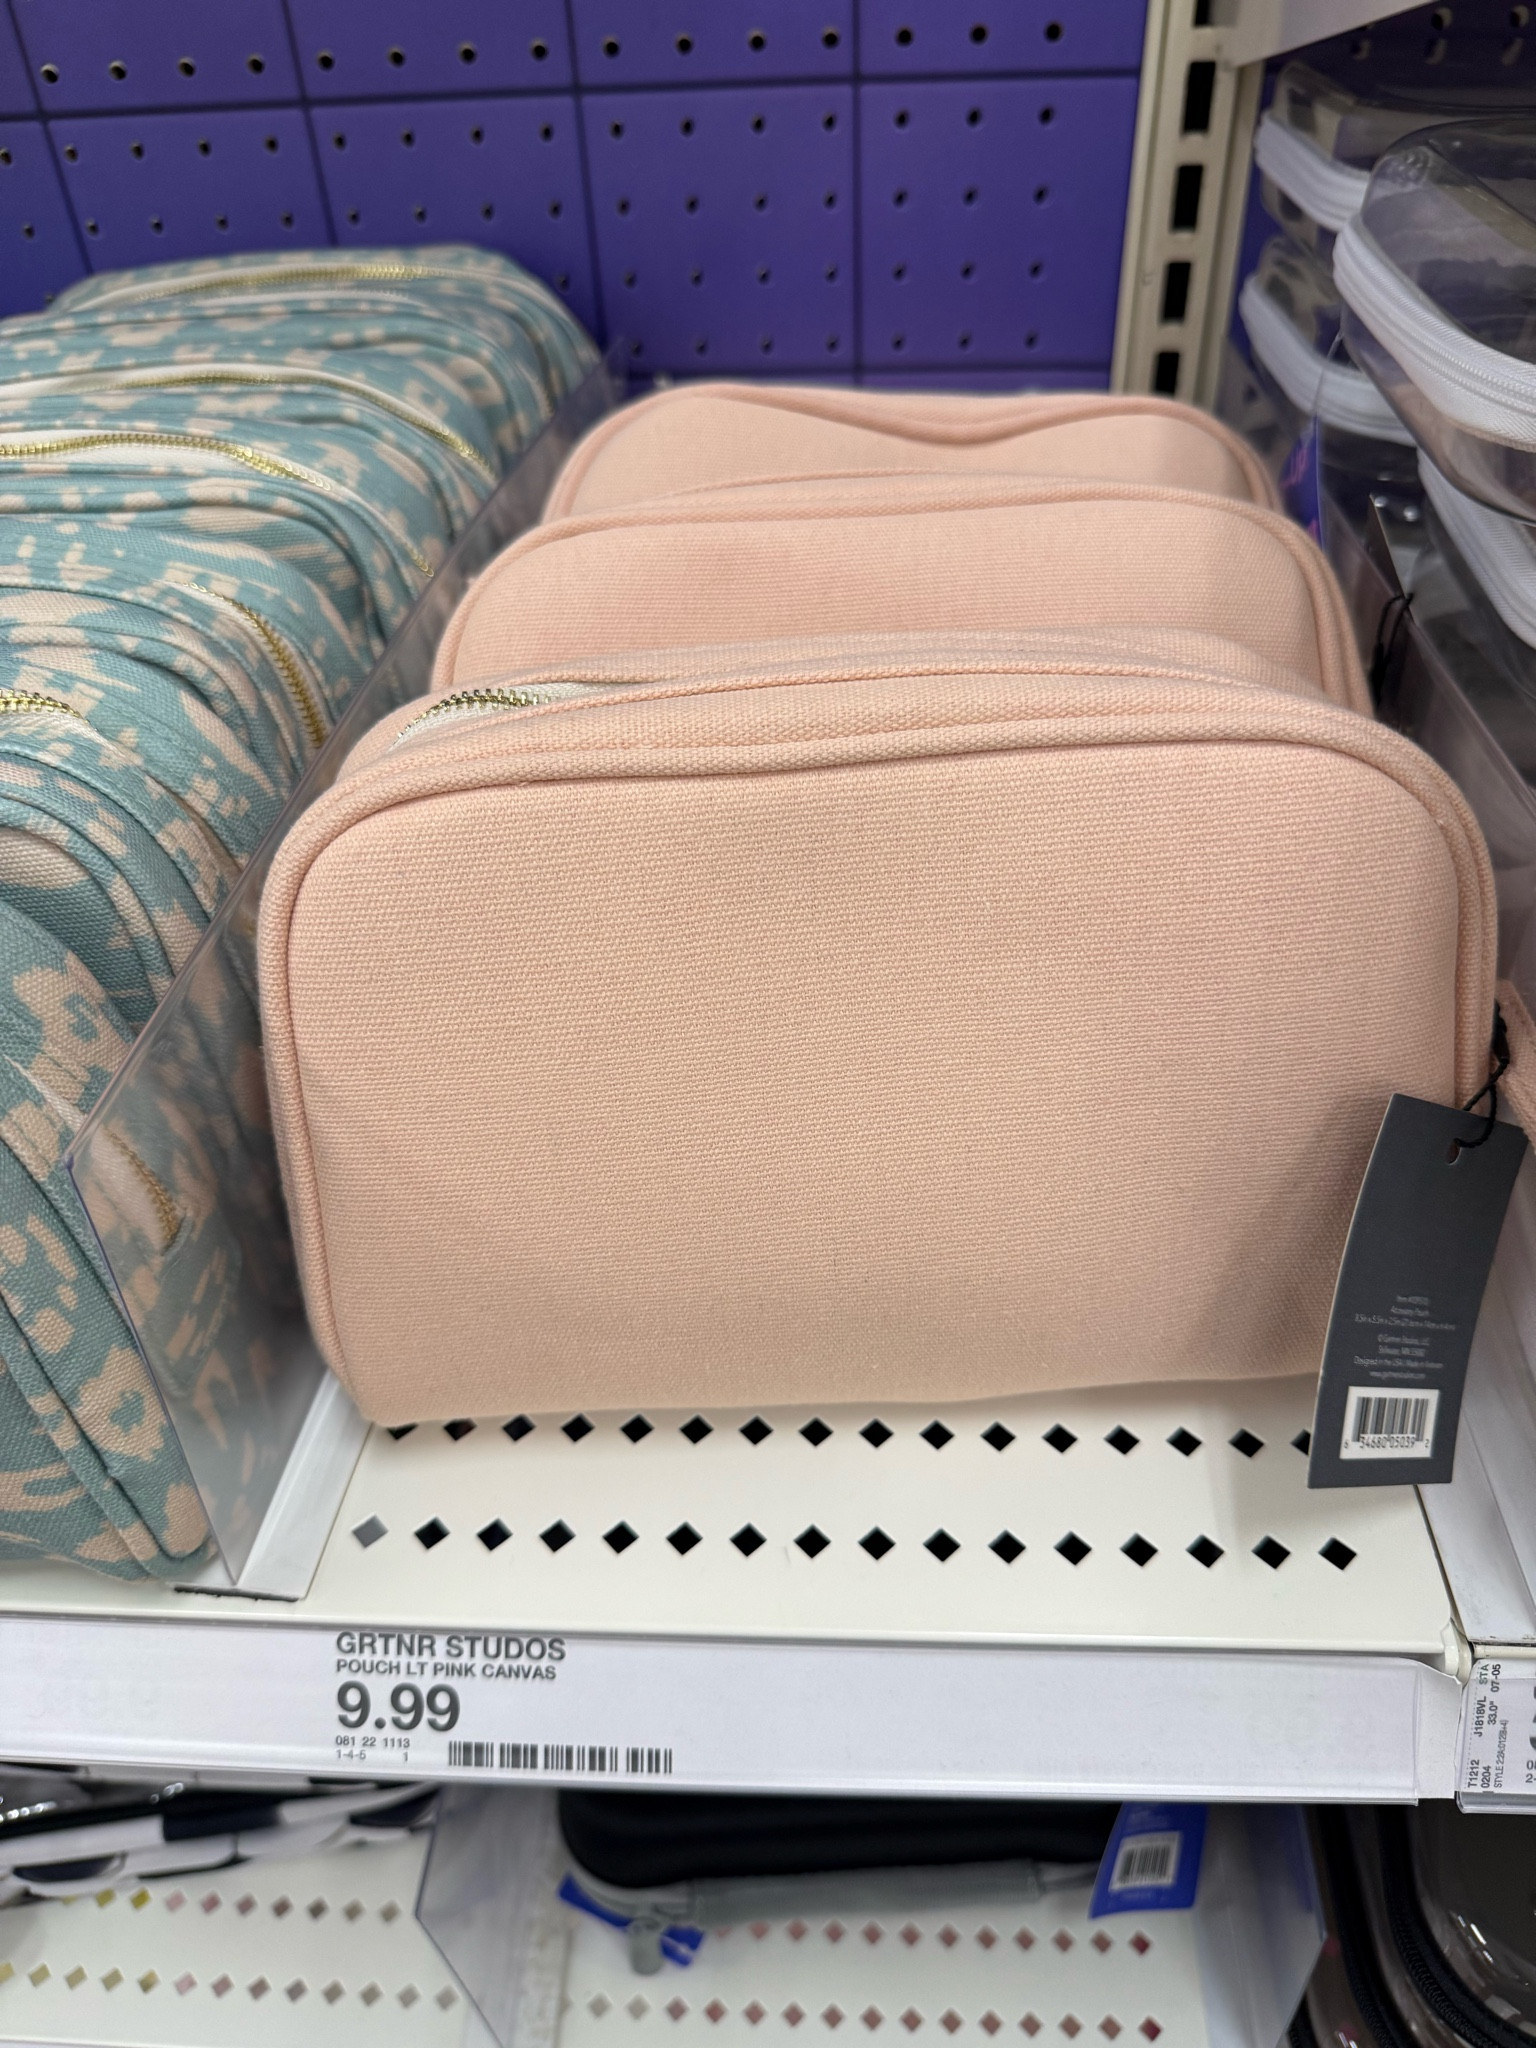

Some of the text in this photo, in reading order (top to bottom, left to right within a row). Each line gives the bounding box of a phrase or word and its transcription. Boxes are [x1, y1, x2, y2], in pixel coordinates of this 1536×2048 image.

[336, 1631, 567, 1661] GRTNR STUDOS
[336, 1659, 557, 1680] POUCH LT PINK CANVAS
[337, 1680, 461, 1732] 9.99
[1468, 1664, 1490, 1788] T1212 J1818VL STA
[1481, 1765, 1492, 1788] 0204
[1490, 1664, 1502, 1692] 07-05
[335, 1735, 411, 1749] 081 22 1113
[402, 1751, 410, 1762] 1
[1493, 1765, 1504, 1788] STYLE
